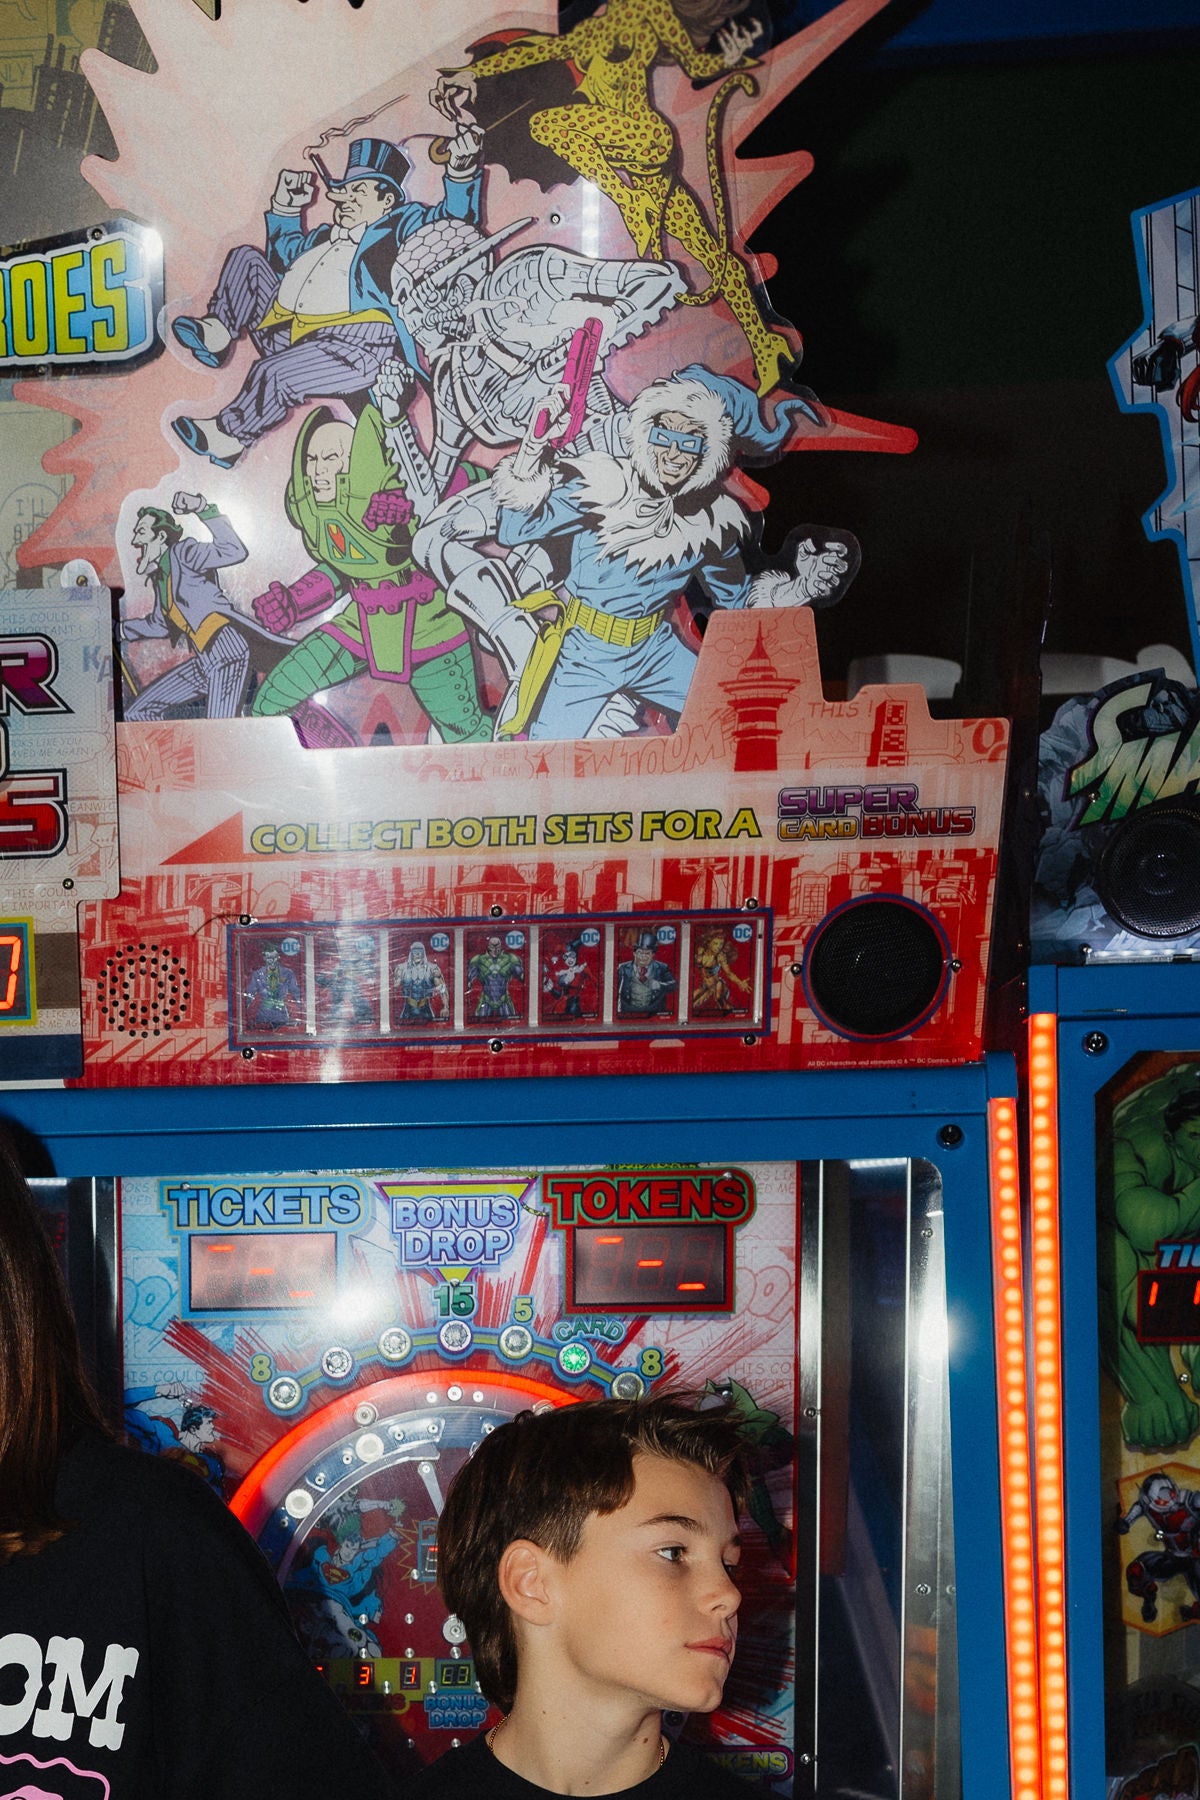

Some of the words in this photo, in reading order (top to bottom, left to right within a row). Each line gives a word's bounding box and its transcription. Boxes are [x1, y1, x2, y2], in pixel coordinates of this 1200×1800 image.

[777, 783, 919, 818] SUPER
[250, 814, 424, 857] COLLECT
[427, 813, 538, 849] BOTH
[543, 810, 635, 846] SETS
[640, 807, 727, 842] FOR
[723, 805, 762, 839] A
[777, 815, 859, 843] CARD
[860, 806, 977, 839] BONUS
[167, 1185, 362, 1228] TICKETS
[396, 1196, 518, 1230] BONUS
[551, 1178, 746, 1222] TOKENS
[403, 1229, 511, 1264] DROP
[434, 1285, 476, 1317] 15
[513, 1297, 533, 1322] 5
[554, 1320, 626, 1344] CARD
[250, 1354, 273, 1383] 8
[641, 1348, 663, 1378] 8
[424, 1694, 490, 1712] BONUS
[429, 1710, 487, 1730] DROP
